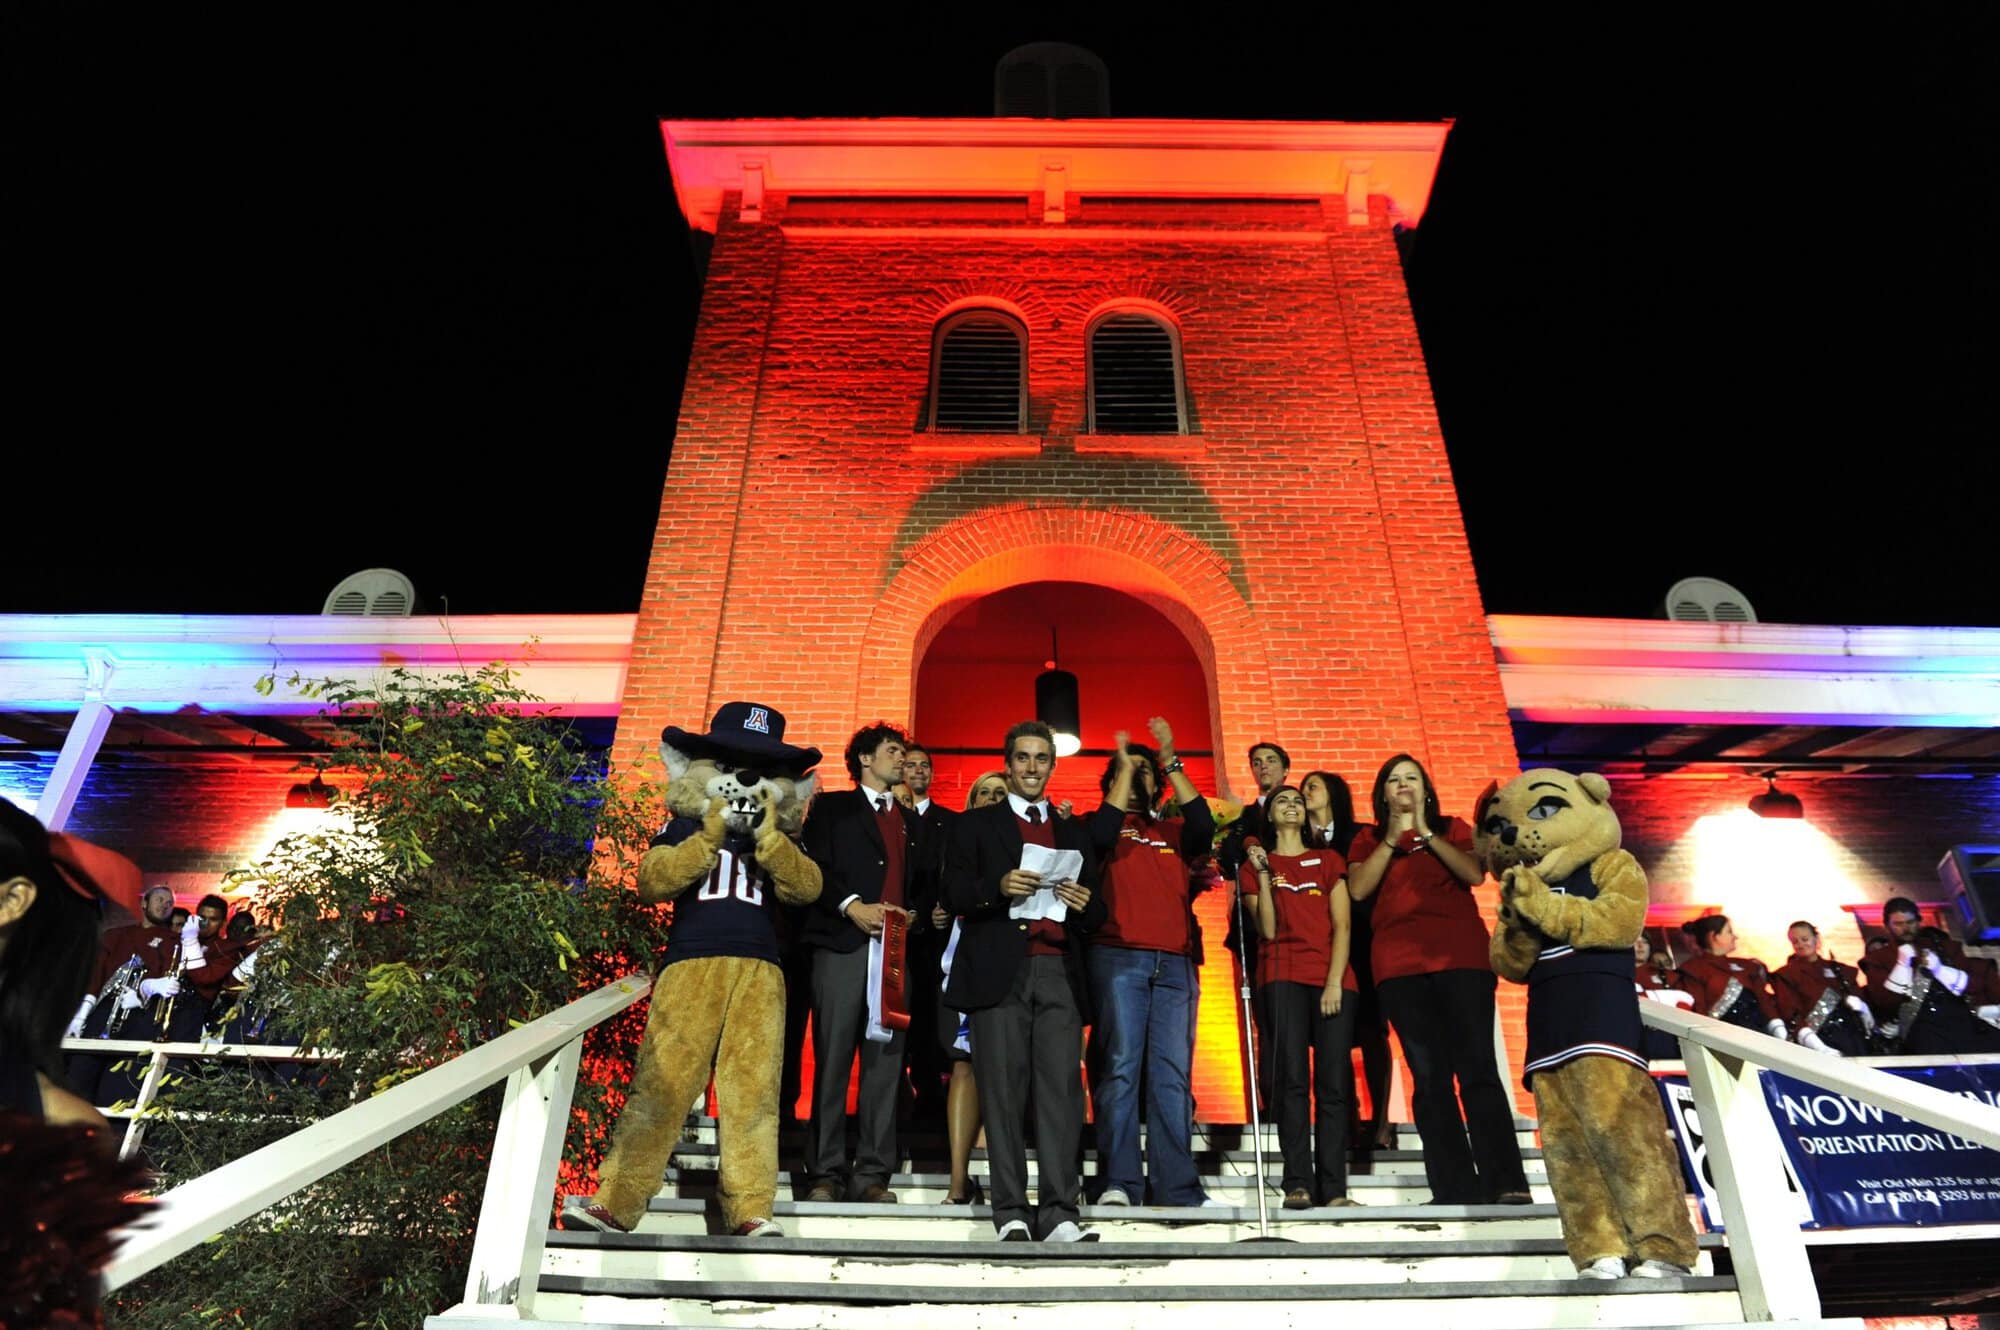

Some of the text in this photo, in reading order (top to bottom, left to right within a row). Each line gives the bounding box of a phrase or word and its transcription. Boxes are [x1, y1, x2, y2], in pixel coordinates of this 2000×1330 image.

[744, 707, 769, 734] A
[1781, 1094, 1884, 1126] NOW
[1799, 1133, 1946, 1155] ORIENTATION
[1934, 1176, 1957, 1187] 235
